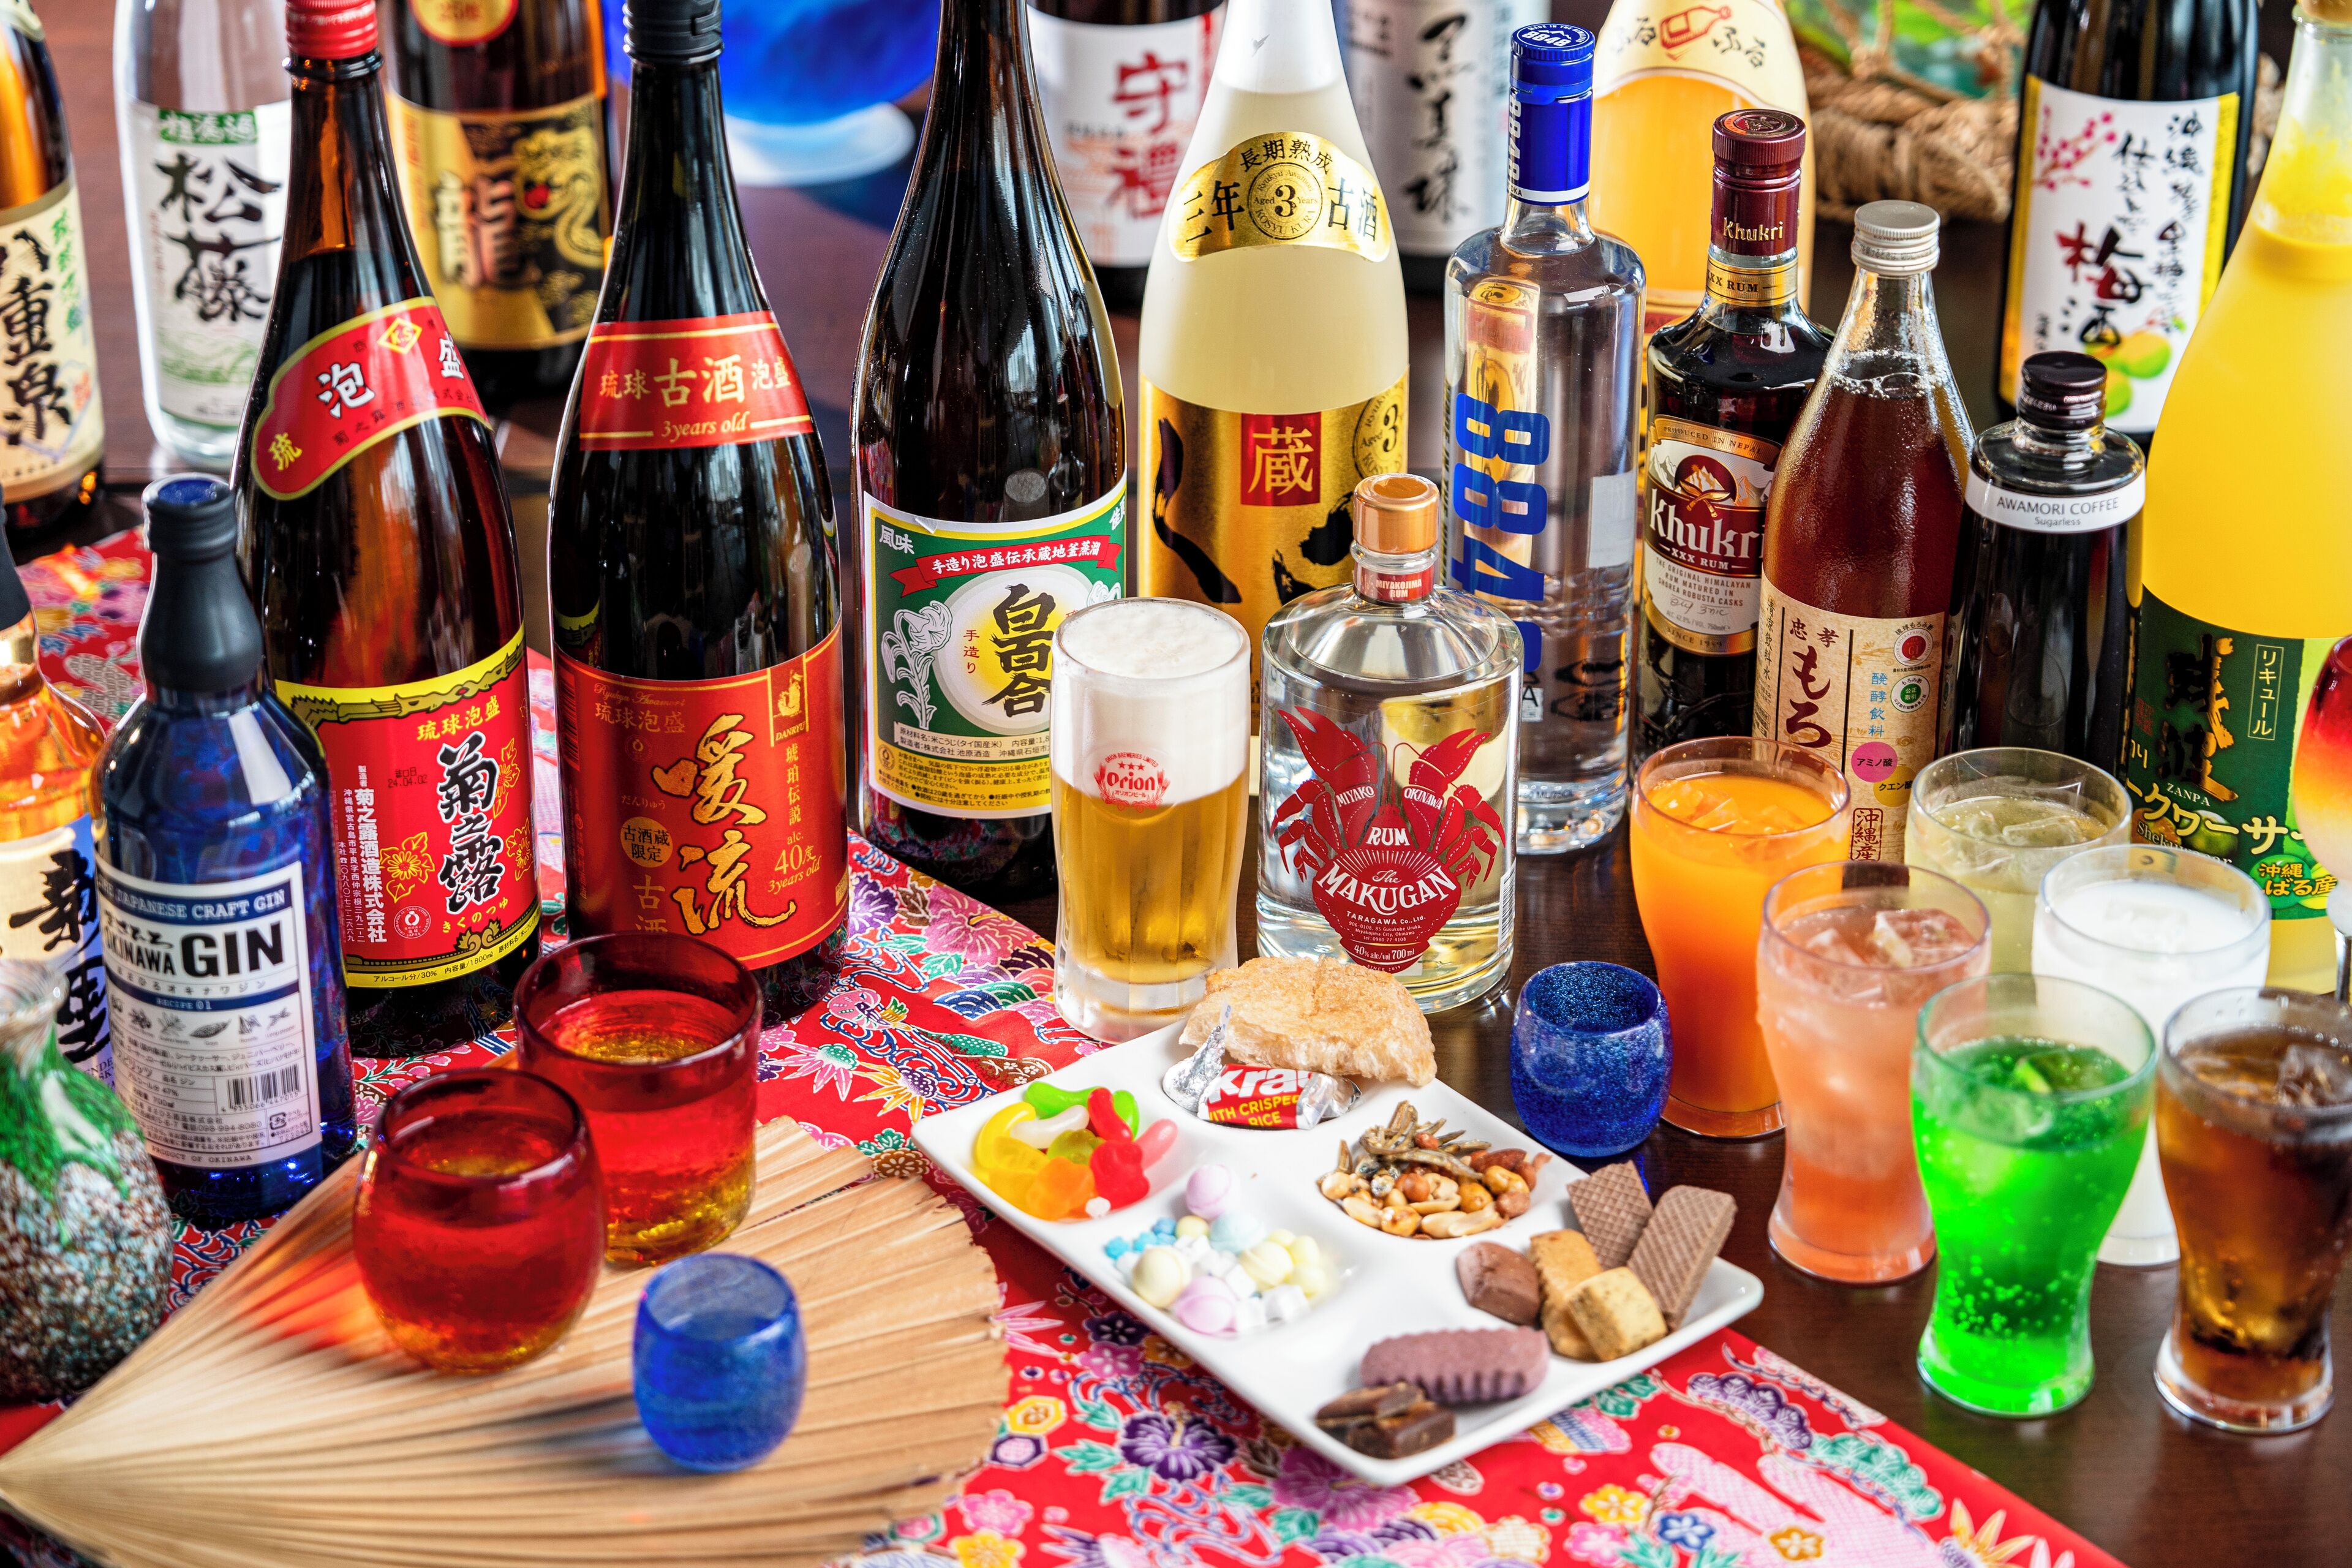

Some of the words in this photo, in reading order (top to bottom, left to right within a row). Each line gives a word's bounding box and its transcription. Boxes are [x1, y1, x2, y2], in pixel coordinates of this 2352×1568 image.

[1521, 31, 1572, 47] 8848
[1240, 138, 1333, 175] 長期熟成
[1254, 196, 1275, 205] Aged
[1273, 184, 1297, 217] 3
[1722, 216, 1784, 243] Khukri
[1727, 282, 1760, 293] RUM
[4, 229, 72, 446] 八重泉
[654, 354, 744, 408] 古酒
[721, 411, 750, 433] old
[1664, 425, 1709, 441] PRODUCED
[1729, 440, 1763, 456] NEPAL
[1247, 426, 1314, 496] 蔵
[1996, 496, 2065, 515] AWAMORI
[2070, 497, 2119, 515] COFFEE
[2034, 517, 2081, 527] Sugarless
[879, 524, 915, 555] 風味
[1670, 549, 1697, 564] XXX
[1700, 558, 1729, 571] RUM
[1376, 579, 1422, 590] MIYAKOJIMA
[1665, 572, 1679, 583] RUM
[1682, 581, 1720, 596] MATURED
[1667, 564, 1701, 582] ORIGINAL
[1704, 576, 1752, 589] HIMALAYAN
[1390, 589, 1408, 598] RUM
[1658, 578, 1681, 594] SHOREA
[1682, 589, 1716, 604] ROBUSTA
[1718, 598, 1744, 607] CASKS
[1667, 627, 1695, 643] SINCE
[1789, 617, 1840, 648] 忠孝
[963, 630, 980, 674] 手造り
[981, 583, 1056, 718] 白百合
[1785, 645, 1833, 748] もろ
[2252, 650, 2277, 736] リキュール
[417, 695, 501, 741] 琉球泡盛
[595, 701, 685, 734] 琉球泡盛
[775, 721, 806, 741] DANRYU
[957, 750, 990, 758] 池原酒造
[999, 745, 1050, 758] 沖縄県石垣市
[1105, 753, 1118, 763] ORION
[1142, 755, 1159, 767] LIMITED
[1856, 757, 1893, 767] アミノ酸
[786, 743, 802, 827] 琥珀伝説
[1106, 772, 1156, 791] Orion
[621, 795, 666, 810] だんりゅう
[1336, 786, 1375, 807] MIYAKO
[1403, 787, 1442, 810] OKINAWA
[2166, 782, 2211, 807] ZANPA
[624, 824, 670, 846] 古酒蔵
[650, 713, 797, 935] 暖流
[1854, 810, 1881, 861] 沖縄産
[786, 831, 804, 845] alc.
[1366, 826, 1411, 846] RUM
[631, 843, 663, 862] 限定
[354, 788, 387, 943] 菊之露酒造株式会社
[805, 856, 821, 878] old
[1371, 869, 1402, 884] The
[2258, 862, 2303, 878] 沖縄
[1316, 860, 1458, 917] MAKUGAN
[116, 888, 187, 919] JAPANESE
[192, 899, 249, 919] CRAFT
[254, 889, 285, 912] GIN
[442, 896, 508, 933] きくのつゆ
[1346, 910, 1397, 925] TARAGAWA
[1355, 928, 1381, 937] Miyakojima
[105, 925, 176, 976] OKINAWA
[182, 921, 284, 979] GIN
[1354, 944, 1370, 957] 40%
[1248, 1110, 1283, 1126] RICE
